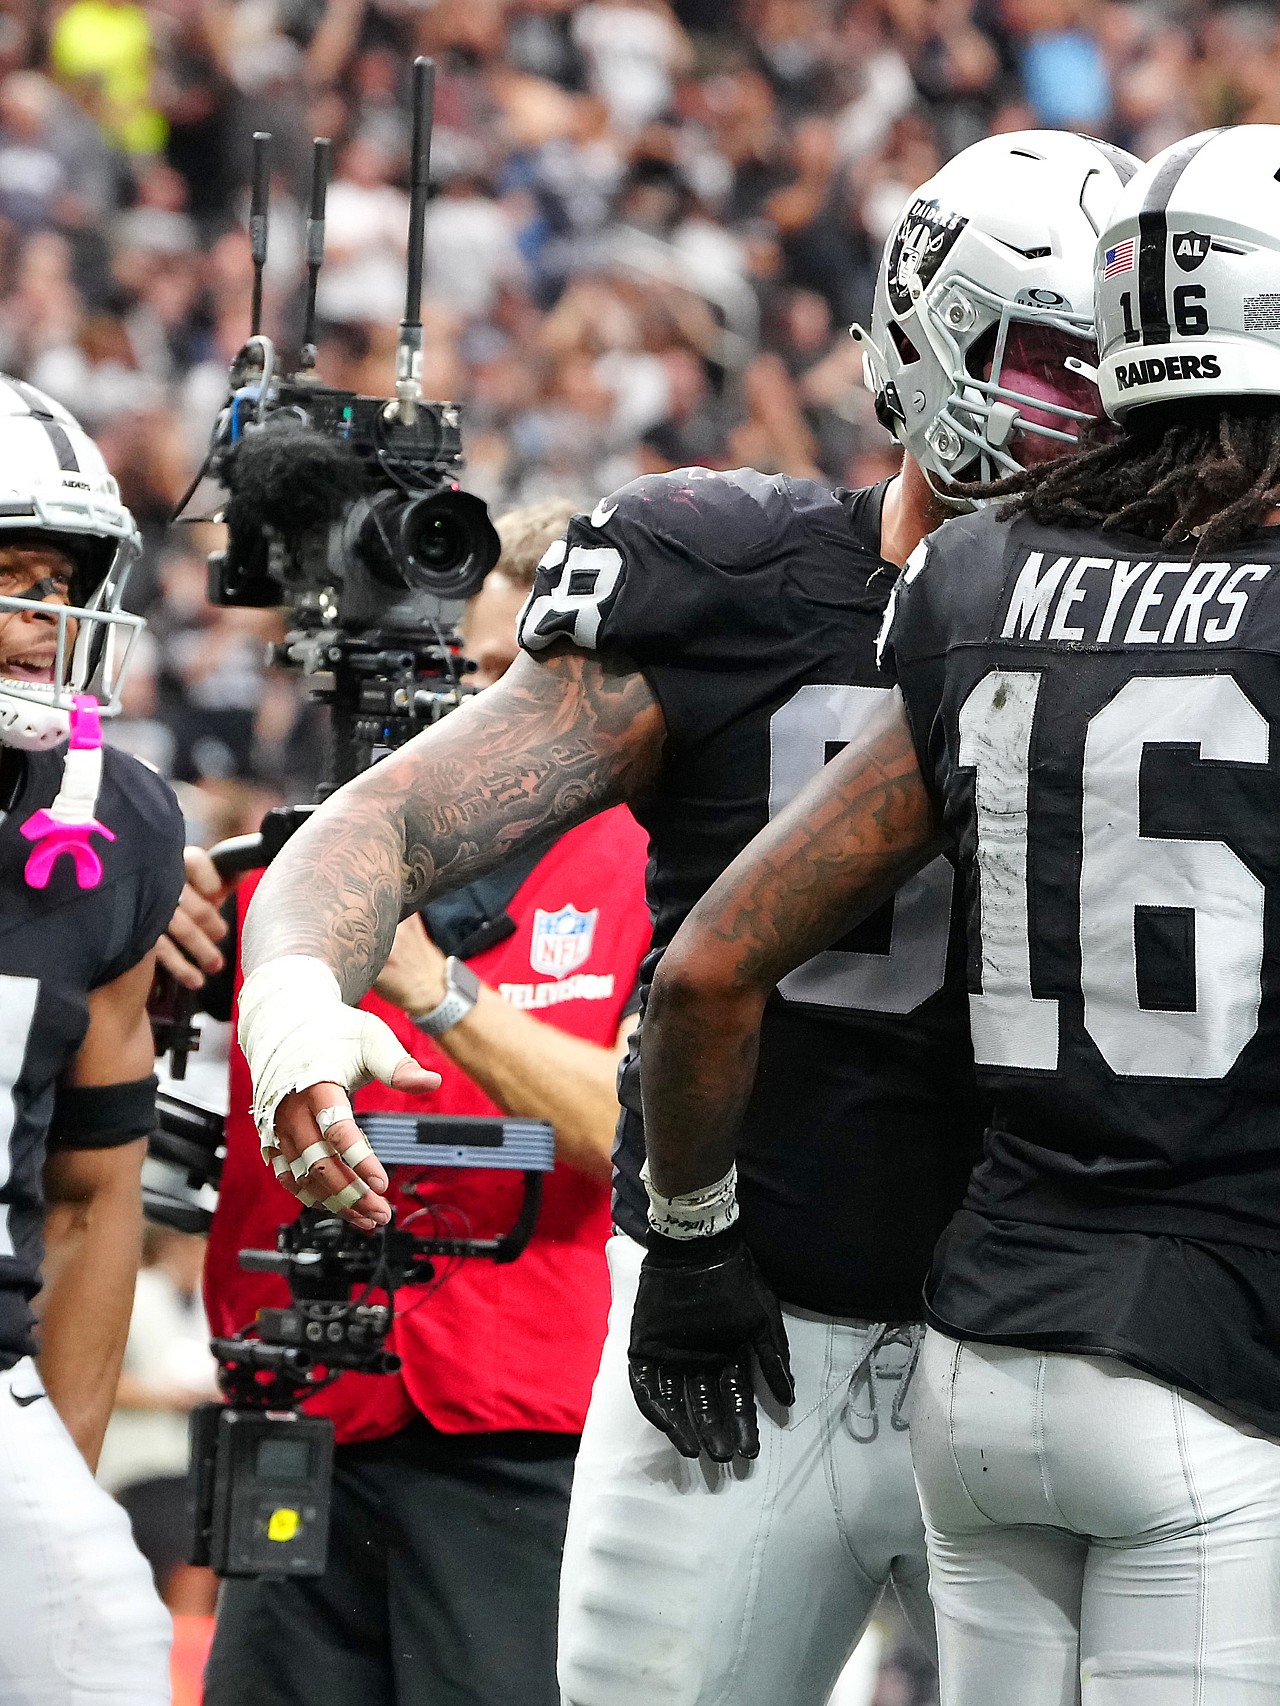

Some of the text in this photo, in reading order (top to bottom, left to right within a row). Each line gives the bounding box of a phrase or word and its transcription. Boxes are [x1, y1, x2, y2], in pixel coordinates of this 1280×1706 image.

[1176, 239, 1204, 257] AL
[1115, 355, 1221, 391] RAIDERS
[1000, 552, 1272, 644] MEYERS
[958, 670, 1270, 1080] 16
[541, 938, 589, 965] NFL
